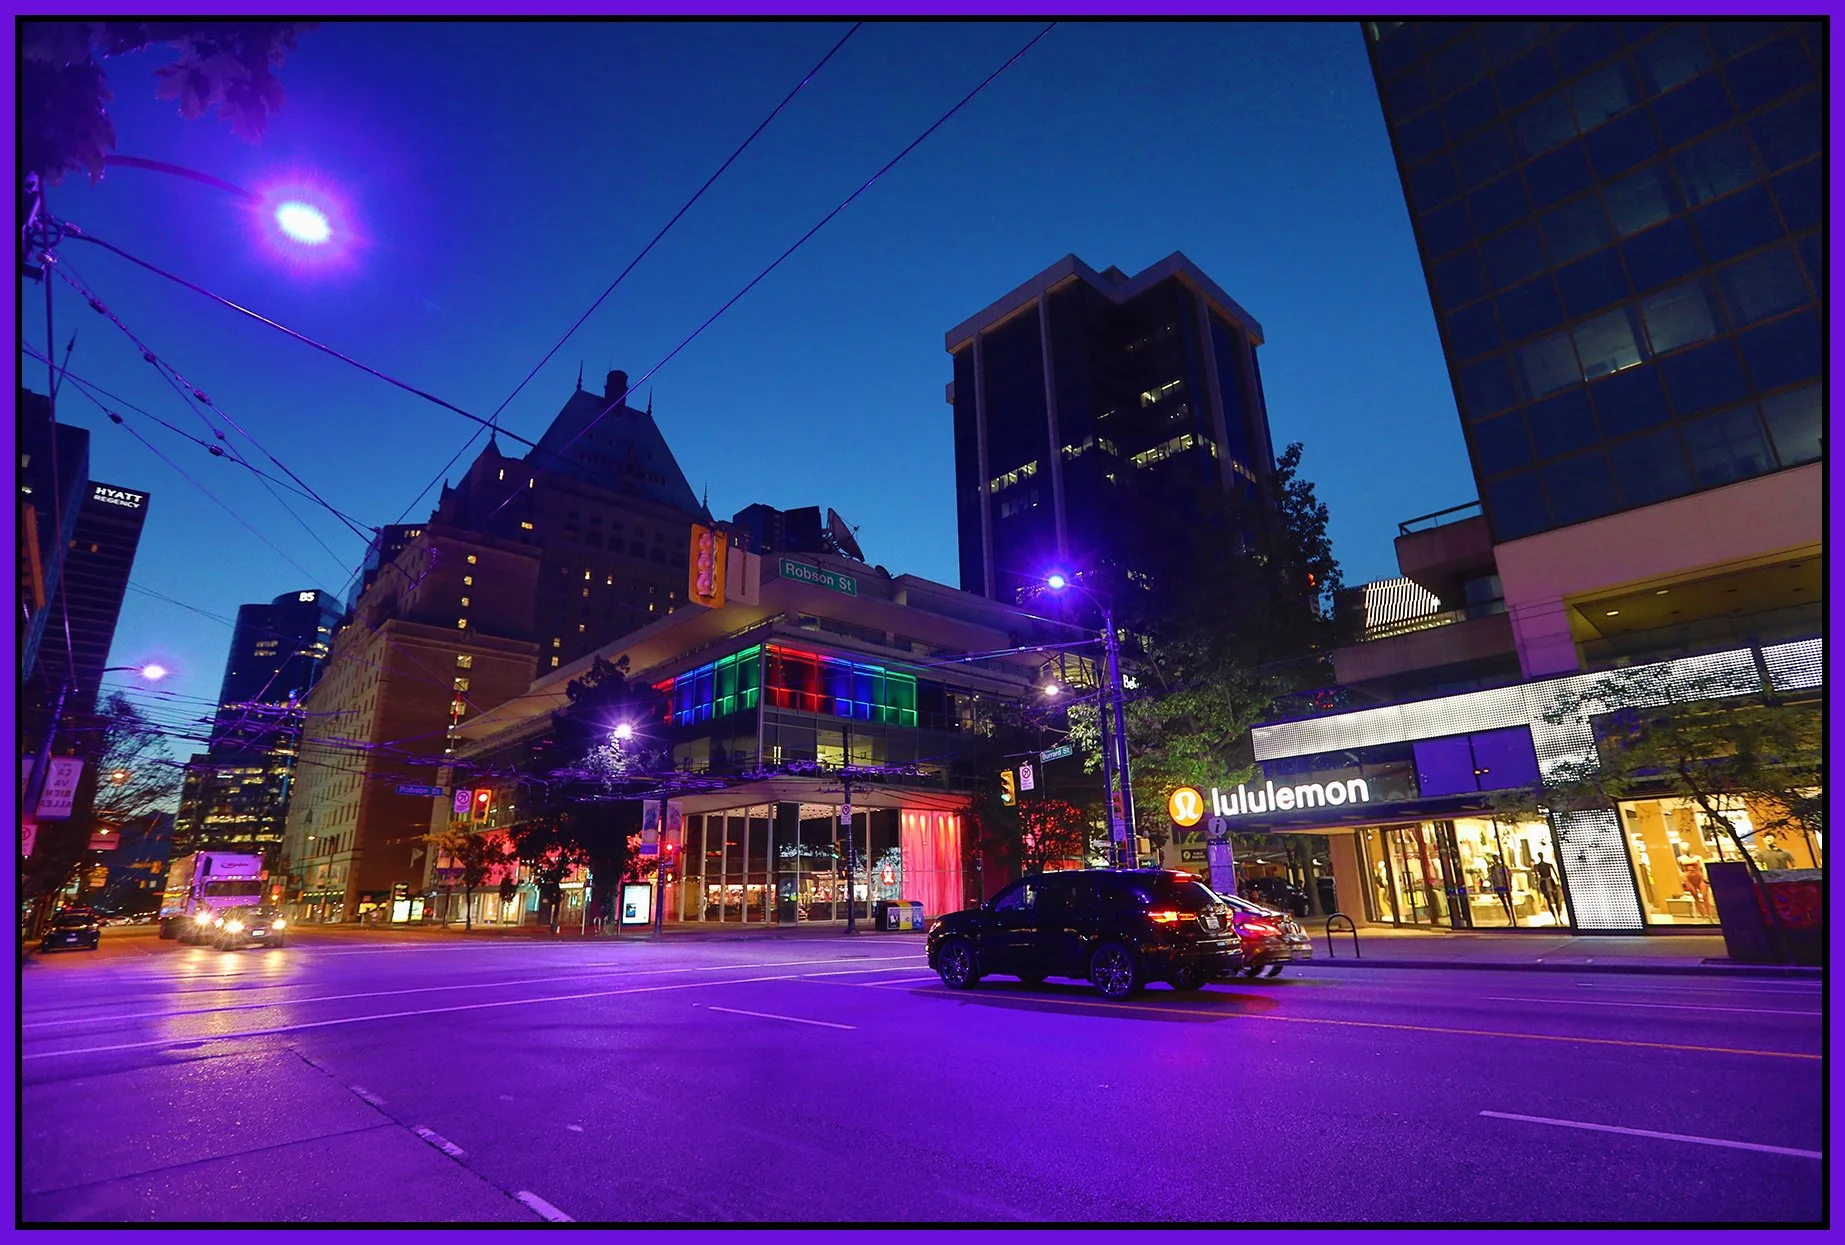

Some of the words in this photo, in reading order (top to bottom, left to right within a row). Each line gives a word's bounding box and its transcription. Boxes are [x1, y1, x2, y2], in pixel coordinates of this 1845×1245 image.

[93, 494, 140, 508] REGENCY
[95, 486, 143, 502] HYATT
[785, 562, 834, 585] Robson
[839, 577, 851, 591] St
[1042, 749, 1061, 760] Burrard
[1062, 746, 1070, 756] St
[399, 785, 429, 795] Robson
[431, 788, 441, 796] St
[1211, 778, 1370, 817] lululemon
